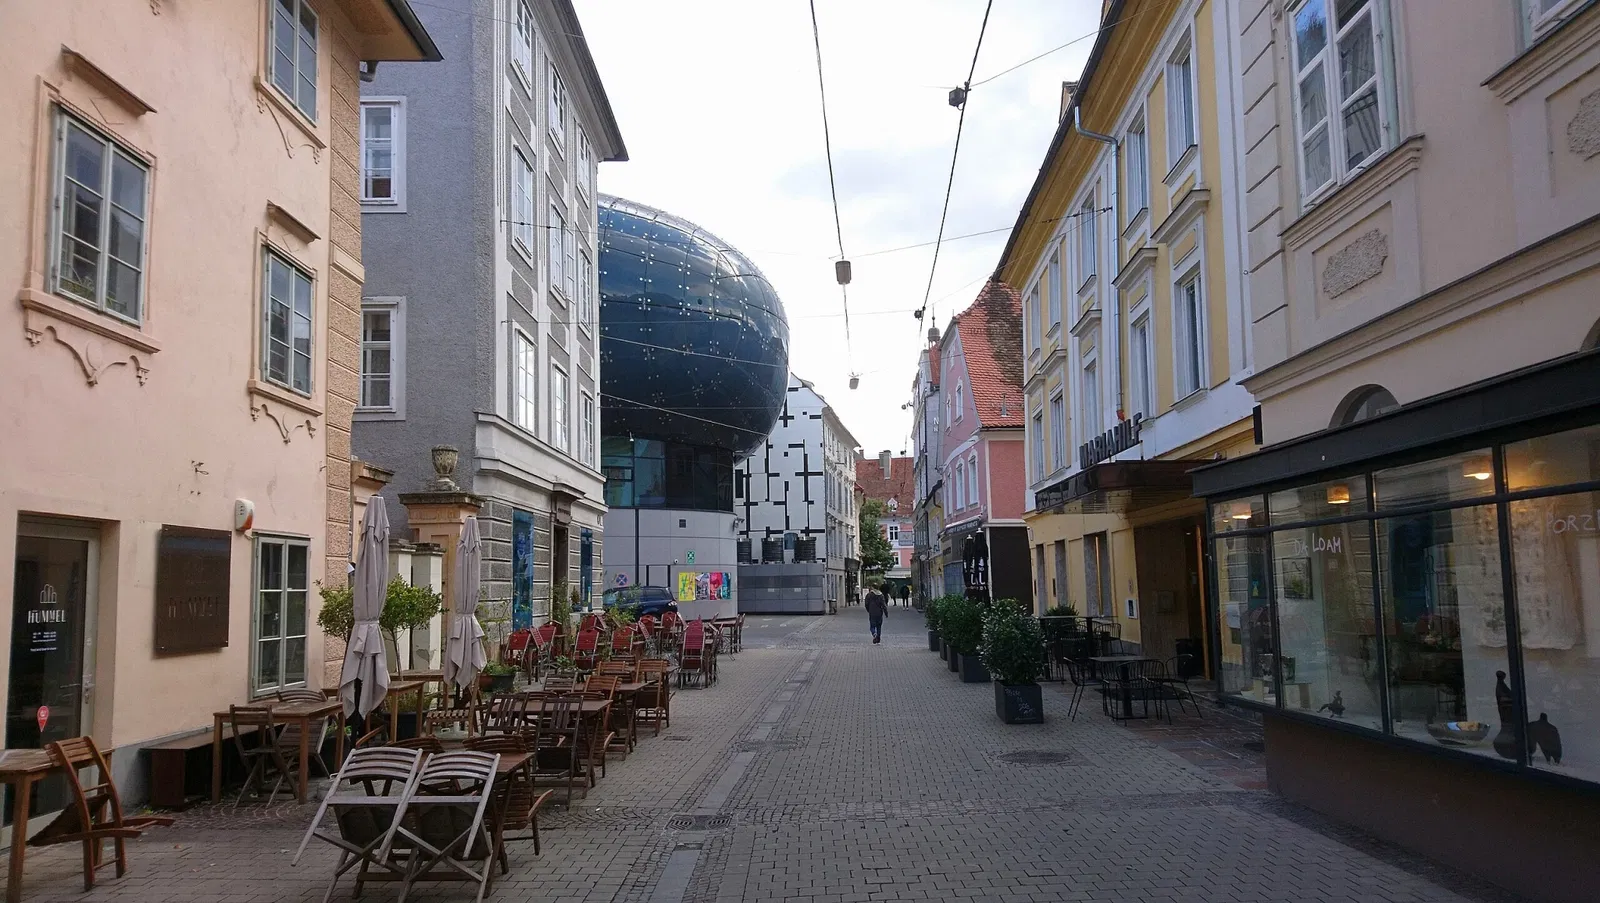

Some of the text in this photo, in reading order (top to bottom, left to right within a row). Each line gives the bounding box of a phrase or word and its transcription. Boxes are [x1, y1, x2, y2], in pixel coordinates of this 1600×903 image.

[1079, 412, 1142, 470] MARIAHILF
[1312, 532, 1342, 553] LOAM
[27, 609, 67, 624] HUMMEL
